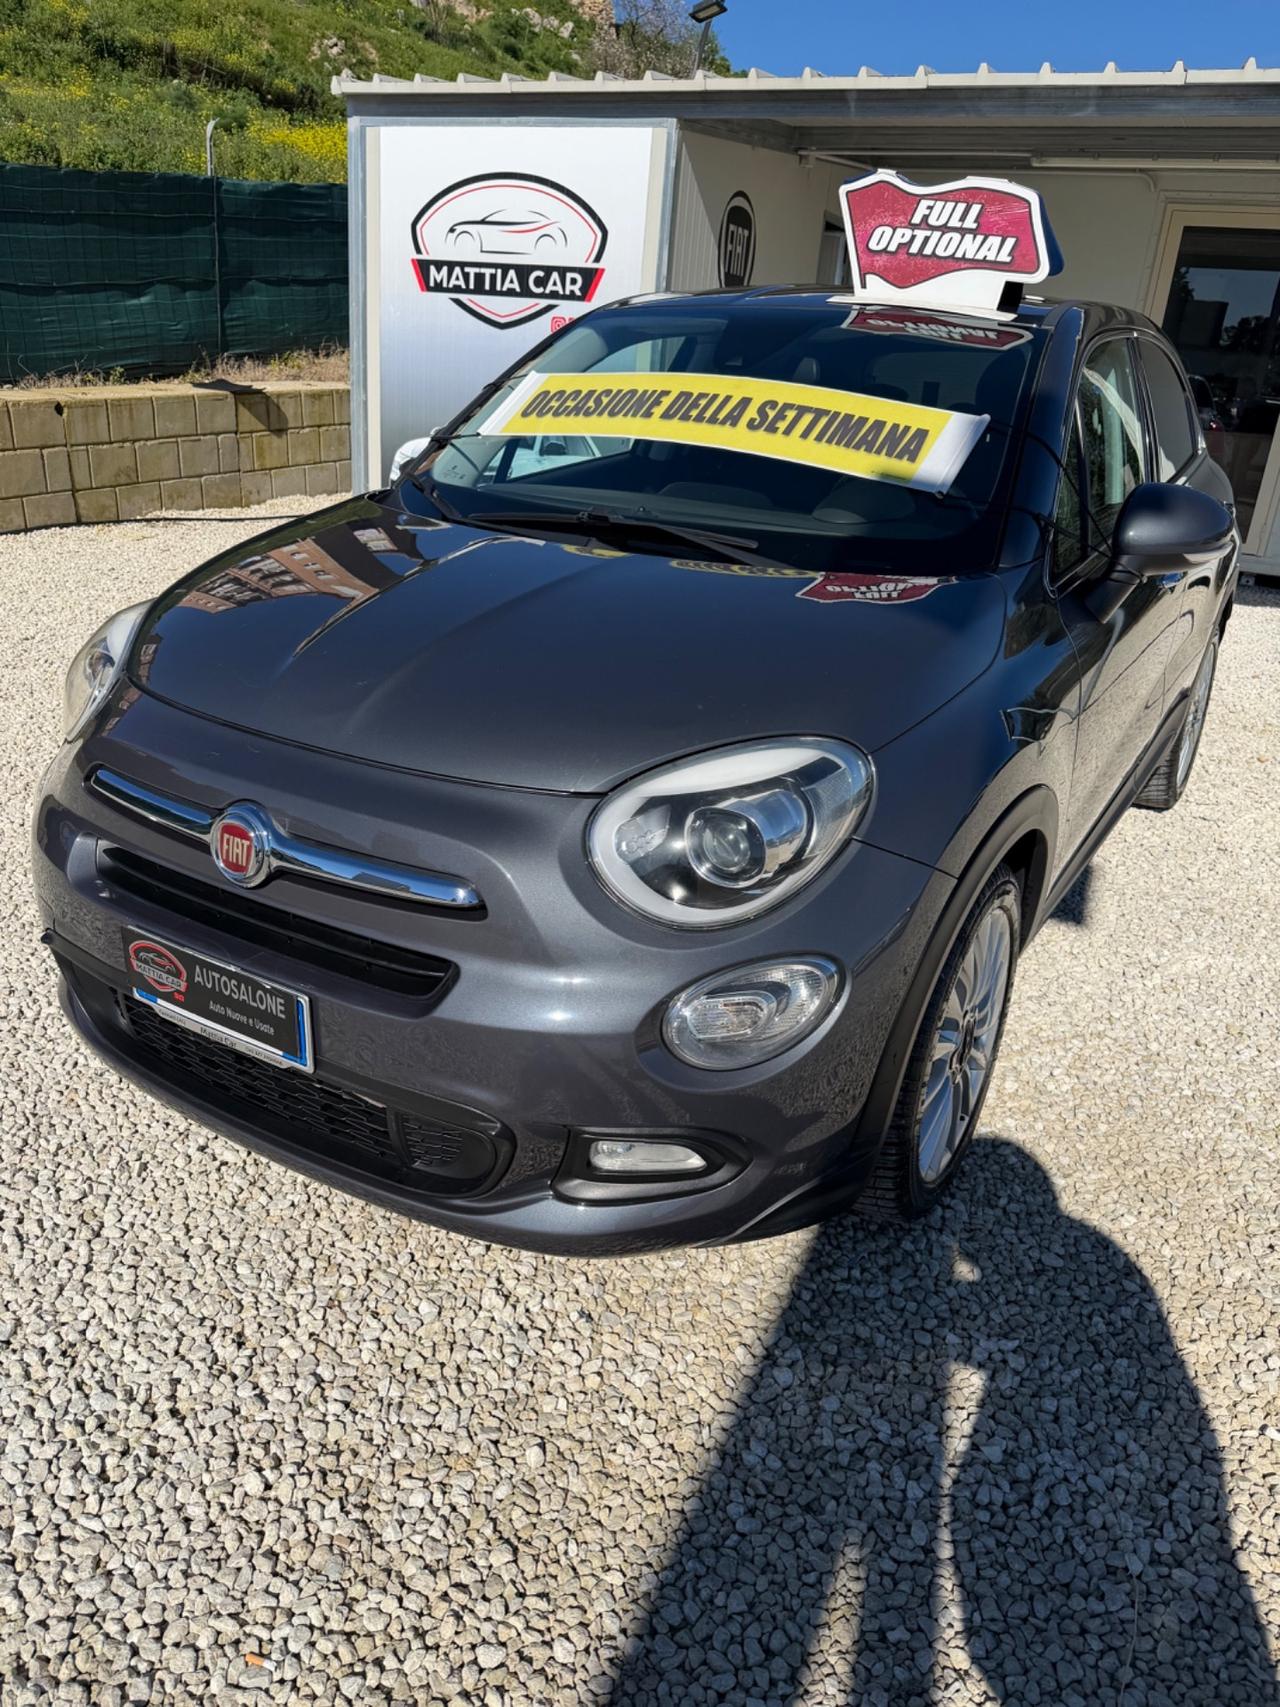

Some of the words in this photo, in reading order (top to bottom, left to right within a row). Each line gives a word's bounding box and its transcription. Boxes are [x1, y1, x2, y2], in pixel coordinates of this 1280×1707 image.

[910, 198, 983, 230] FULL
[724, 223, 750, 277] FIAT
[867, 225, 1017, 263] OPTIONAL
[429, 264, 521, 293] MATTIA
[528, 270, 583, 297] CAR
[521, 388, 671, 419] OCCASIONE
[659, 391, 753, 428] DELLA
[746, 399, 930, 464] SETTIMANA
[223, 833, 250, 867] FIAT
[194, 965, 286, 1019] AUTOSALONE
[208, 1000, 226, 1015] Auto
[226, 1007, 248, 1025] Nuove
[248, 1017, 254, 1026] e
[254, 1018, 275, 1036] Usate
